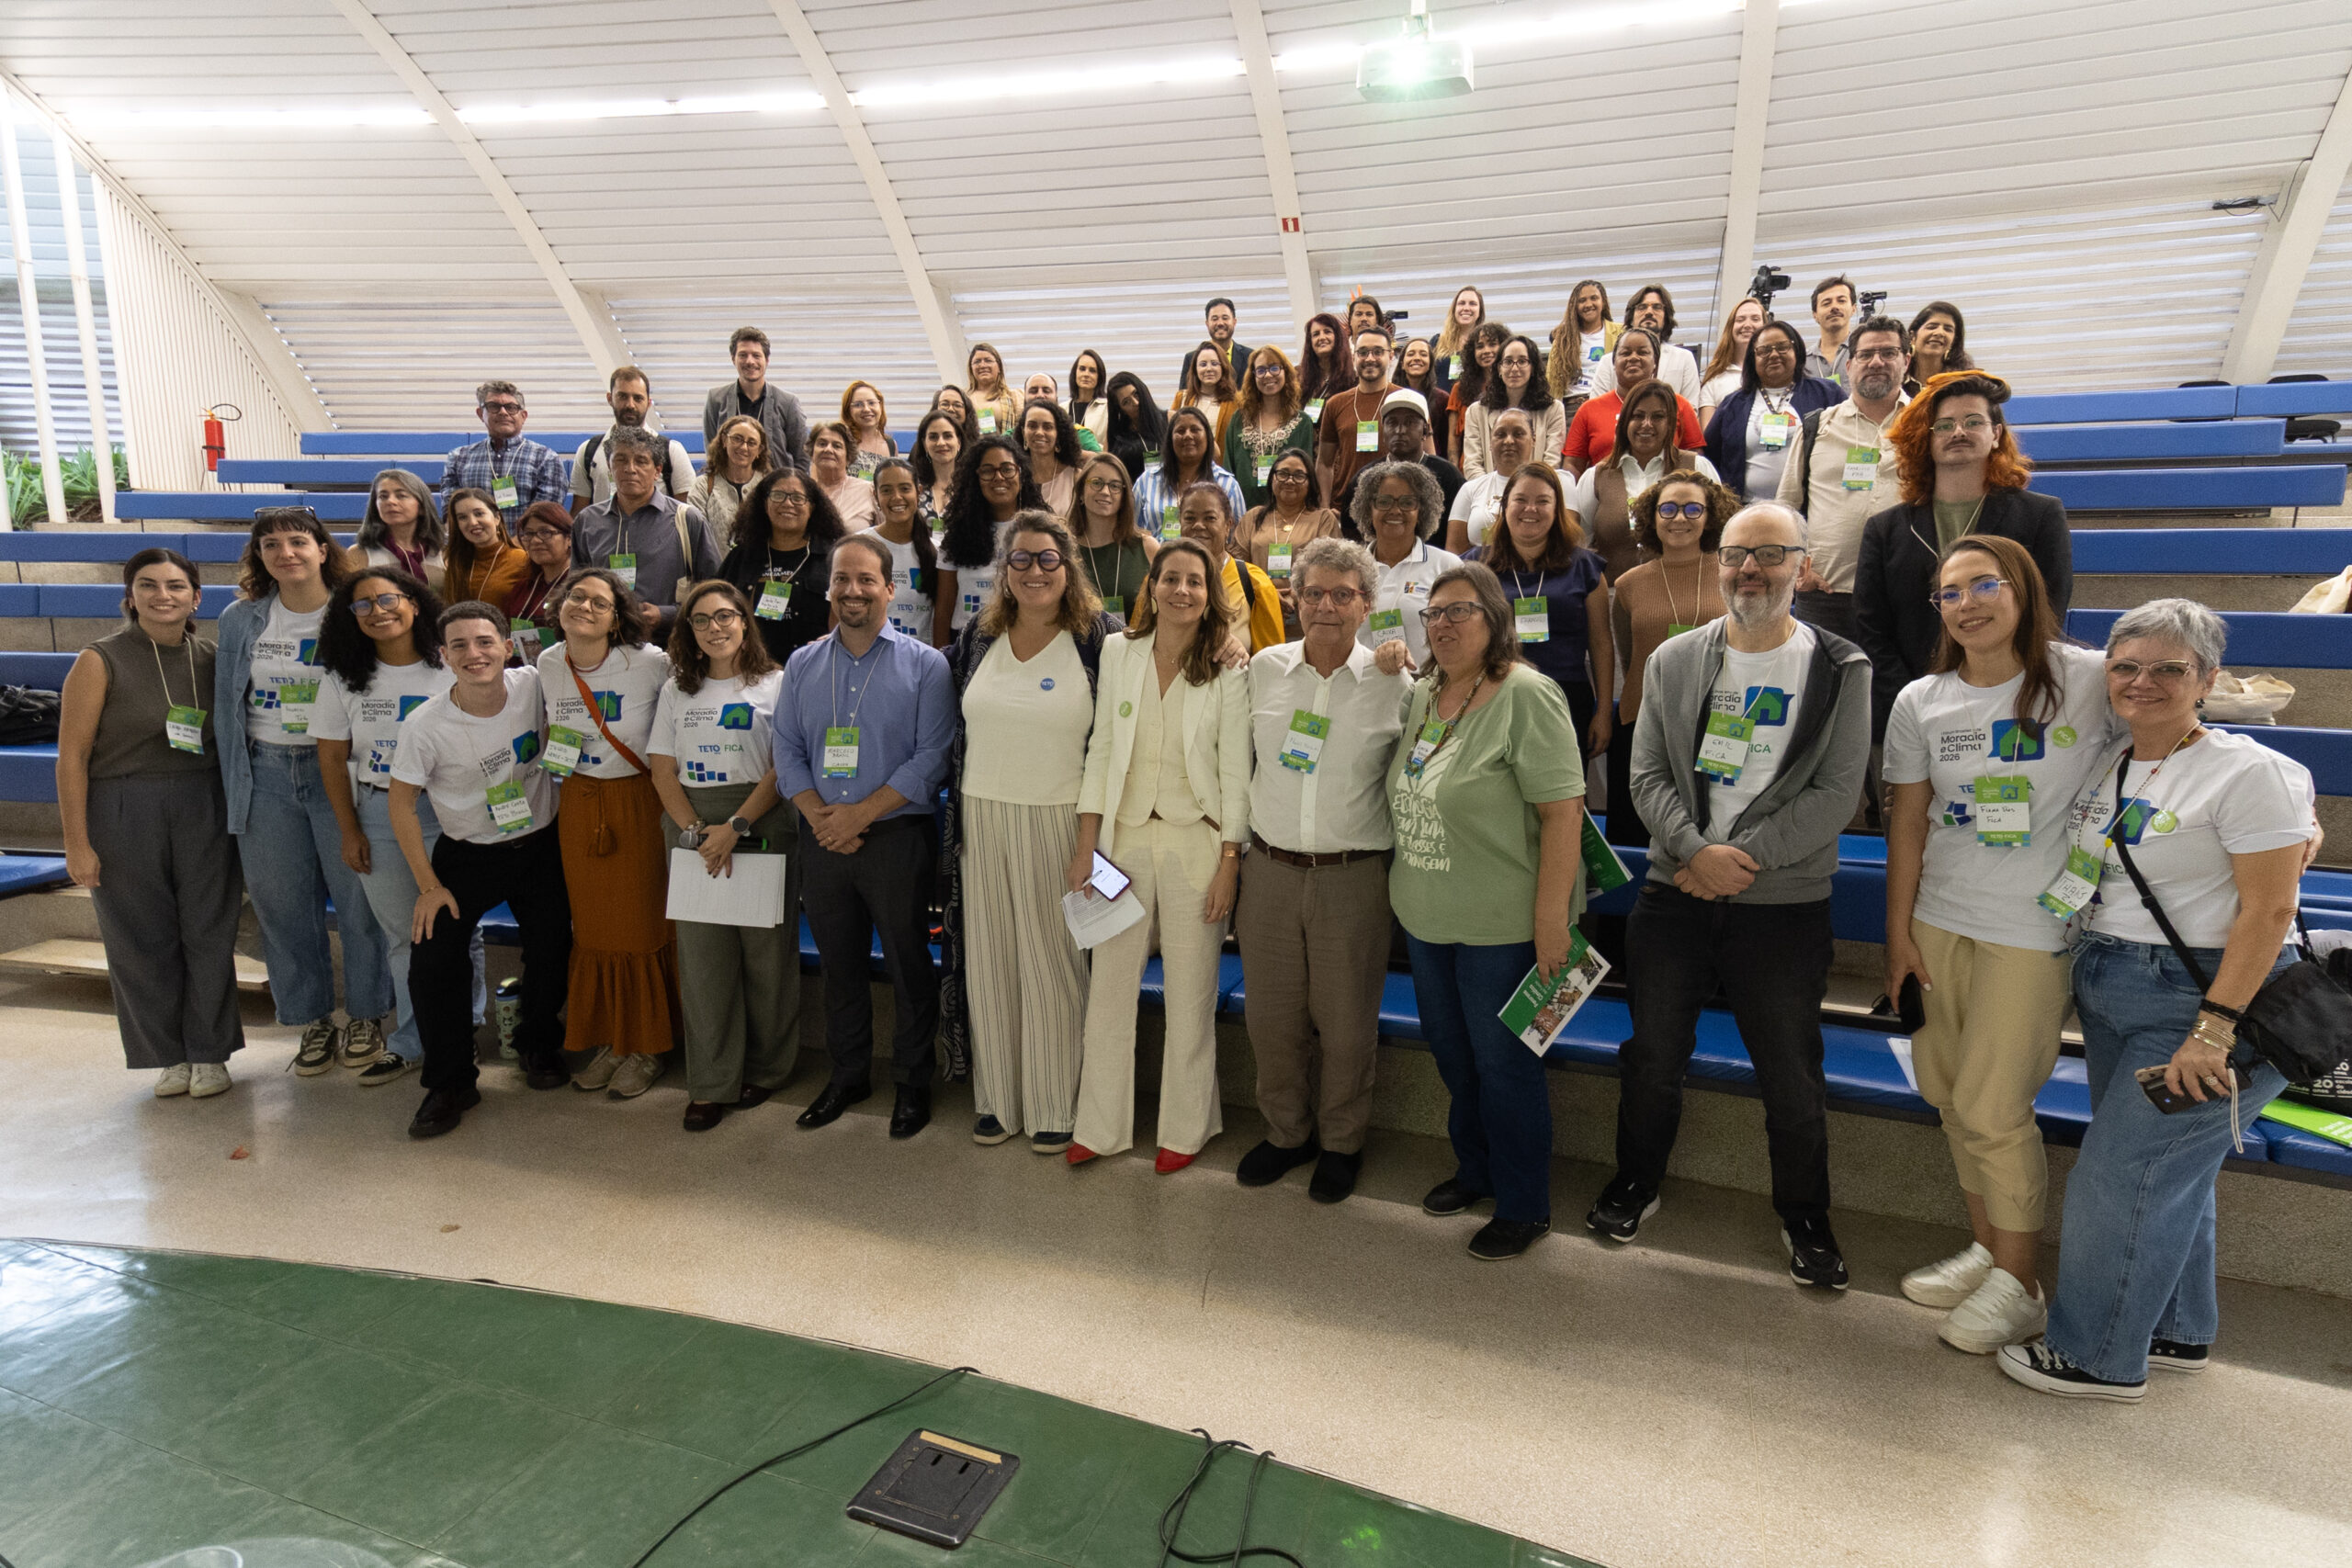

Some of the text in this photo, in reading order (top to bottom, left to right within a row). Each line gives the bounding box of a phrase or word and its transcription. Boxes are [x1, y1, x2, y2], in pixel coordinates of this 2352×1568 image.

[1941, 732, 1986, 745] Moradia
[698, 745, 720, 753] TETO
[1948, 743, 1982, 753] Clima
[1939, 753, 1961, 762] 2026
[1959, 784, 1975, 794] TE
[1420, 818, 1444, 840] LUTA
[2104, 863, 2128, 875] FIC
[2313, 1079, 2334, 1089] 20
